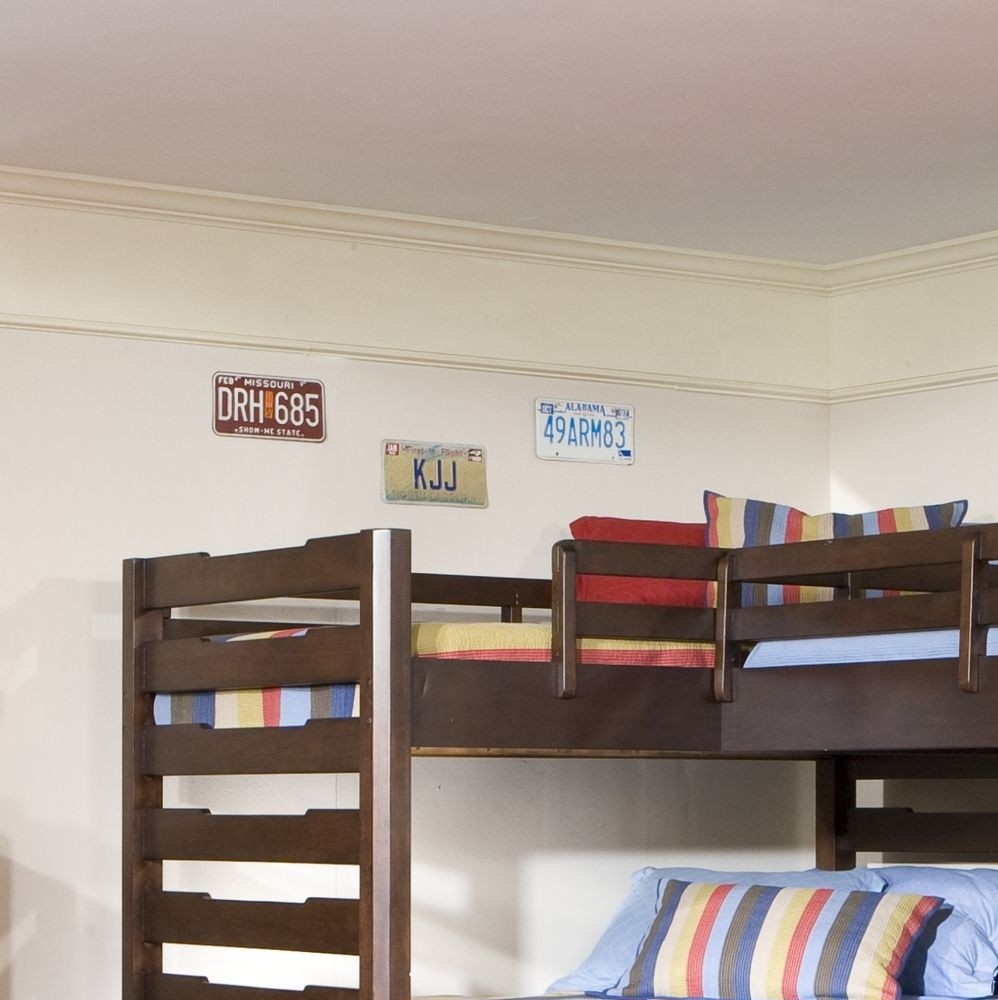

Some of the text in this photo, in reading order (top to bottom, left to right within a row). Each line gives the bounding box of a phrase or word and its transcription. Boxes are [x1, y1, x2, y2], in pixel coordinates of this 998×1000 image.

[218, 376, 234, 385] FEB
[244, 379, 294, 389] MISSOURI
[217, 386, 264, 424] DRH
[274, 391, 320, 427] 685
[565, 402, 605, 415] ALABAMA
[276, 429, 301, 437] STATE
[544, 415, 625, 449] 49ARM83
[413, 458, 457, 491] KJJ
